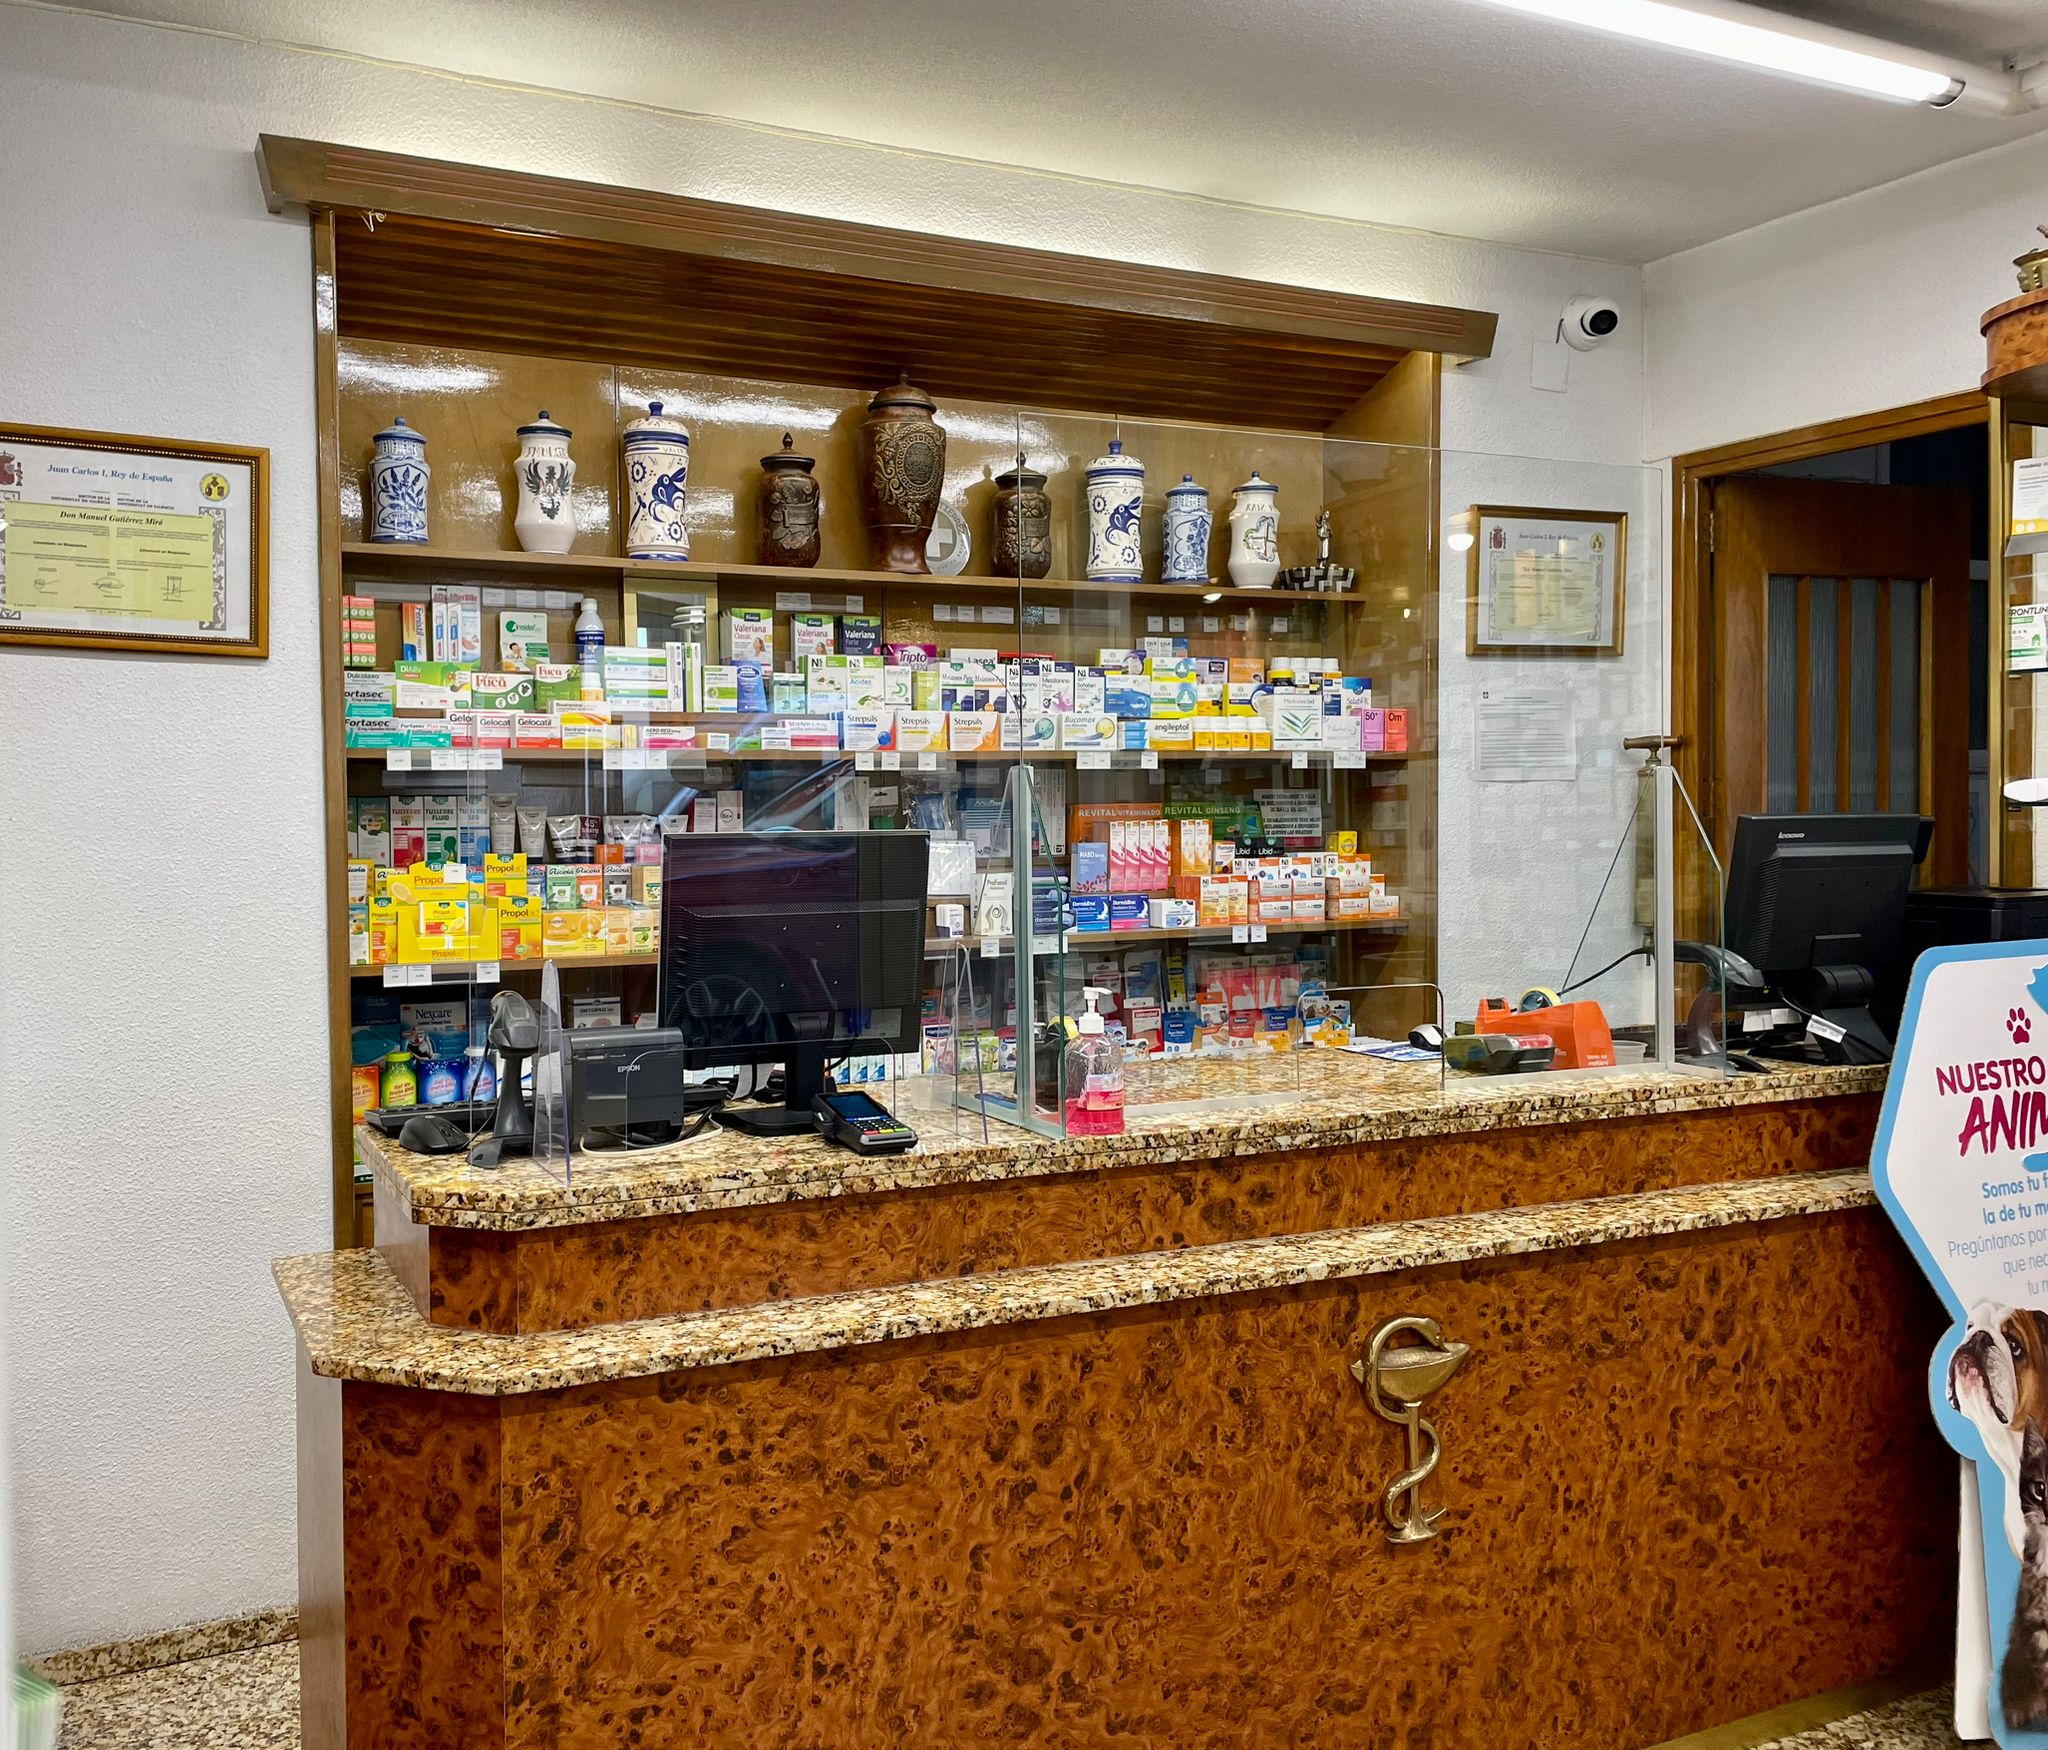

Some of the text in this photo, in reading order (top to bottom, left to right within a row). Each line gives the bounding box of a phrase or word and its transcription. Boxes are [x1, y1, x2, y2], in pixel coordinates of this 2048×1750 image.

[48, 464, 69, 474] Juan
[72, 466, 99, 476] Carlos
[111, 470, 127, 479] Rey
[129, 471, 140, 480] de
[142, 473, 173, 483] España
[60, 511, 163, 526] Don Manuel Gutiérrez Miró
[734, 623, 767, 634] Valeriana
[797, 628, 828, 638] Valeriana
[845, 630, 876, 639] Valeriana
[899, 650, 927, 662] Tripto
[344, 690, 384, 698] ortasec
[345, 718, 390, 727] Fortasec
[480, 718, 511, 726] Gelocat
[518, 718, 552, 727] Gelocatil
[847, 714, 878, 724] Strepsils
[901, 717, 930, 726] Strepsils
[954, 718, 983, 727] Strepsils
[1064, 716, 1097, 724] Bucomax
[1154, 720, 1190, 732] angileptol
[1079, 808, 1161, 817] REVITAL VITAMINADO
[1165, 806, 1241, 815] REVITAL GINSENG
[1778, 831, 1805, 839] lenovo
[549, 867, 574, 875] Ricola
[414, 875, 444, 886] Propo
[415, 1008, 452, 1020] Nexcare
[617, 1064, 641, 1073] EPSON
[1936, 1055, 2046, 1096] NUESTRO
[1981, 1180, 2025, 1199] Somos
[2027, 1175, 2040, 1192] tu
[1982, 1207, 1996, 1225] la
[1999, 1204, 2016, 1223] de
[2018, 1203, 2032, 1219] tu
[1948, 1228, 2048, 1259] Pregúntanos por
[2003, 1257, 2026, 1278] que
[2027, 1279, 2040, 1296] tu
